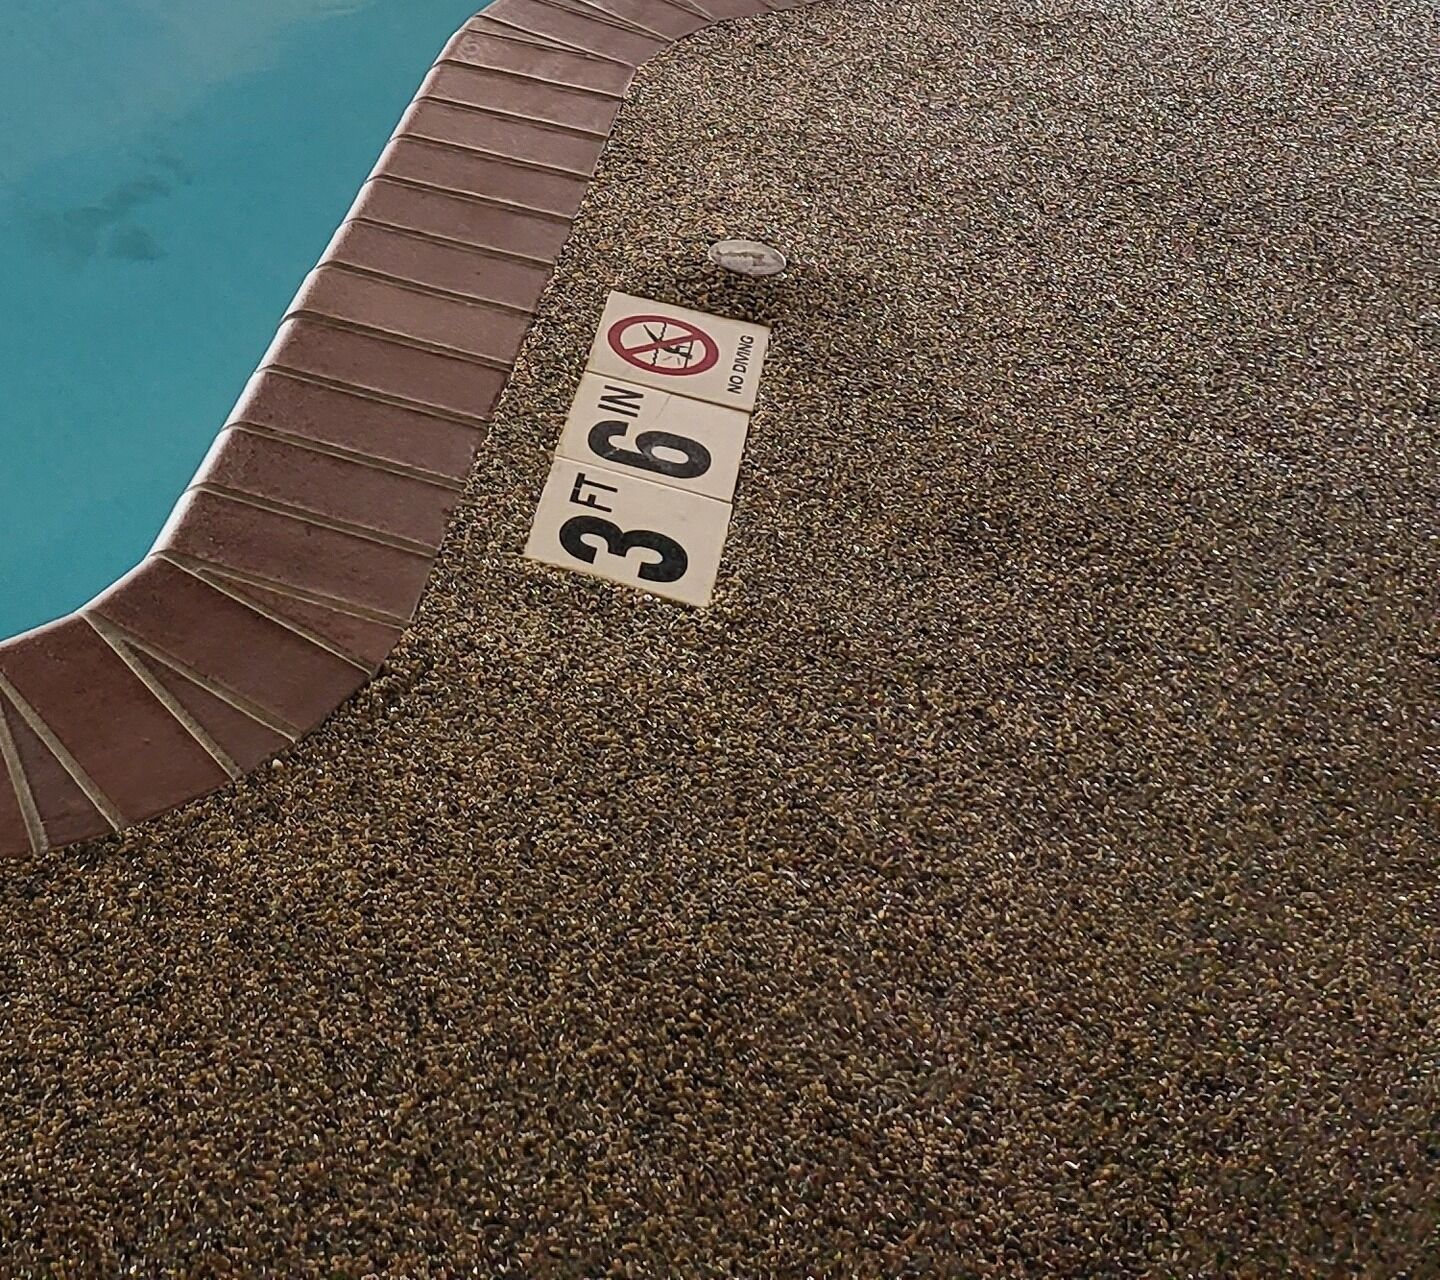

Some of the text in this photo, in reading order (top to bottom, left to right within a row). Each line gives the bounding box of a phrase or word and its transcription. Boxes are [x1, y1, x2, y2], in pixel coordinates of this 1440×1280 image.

[727, 335, 754, 394] NO DIVING
[559, 384, 711, 582] 3 FT 6 IN
